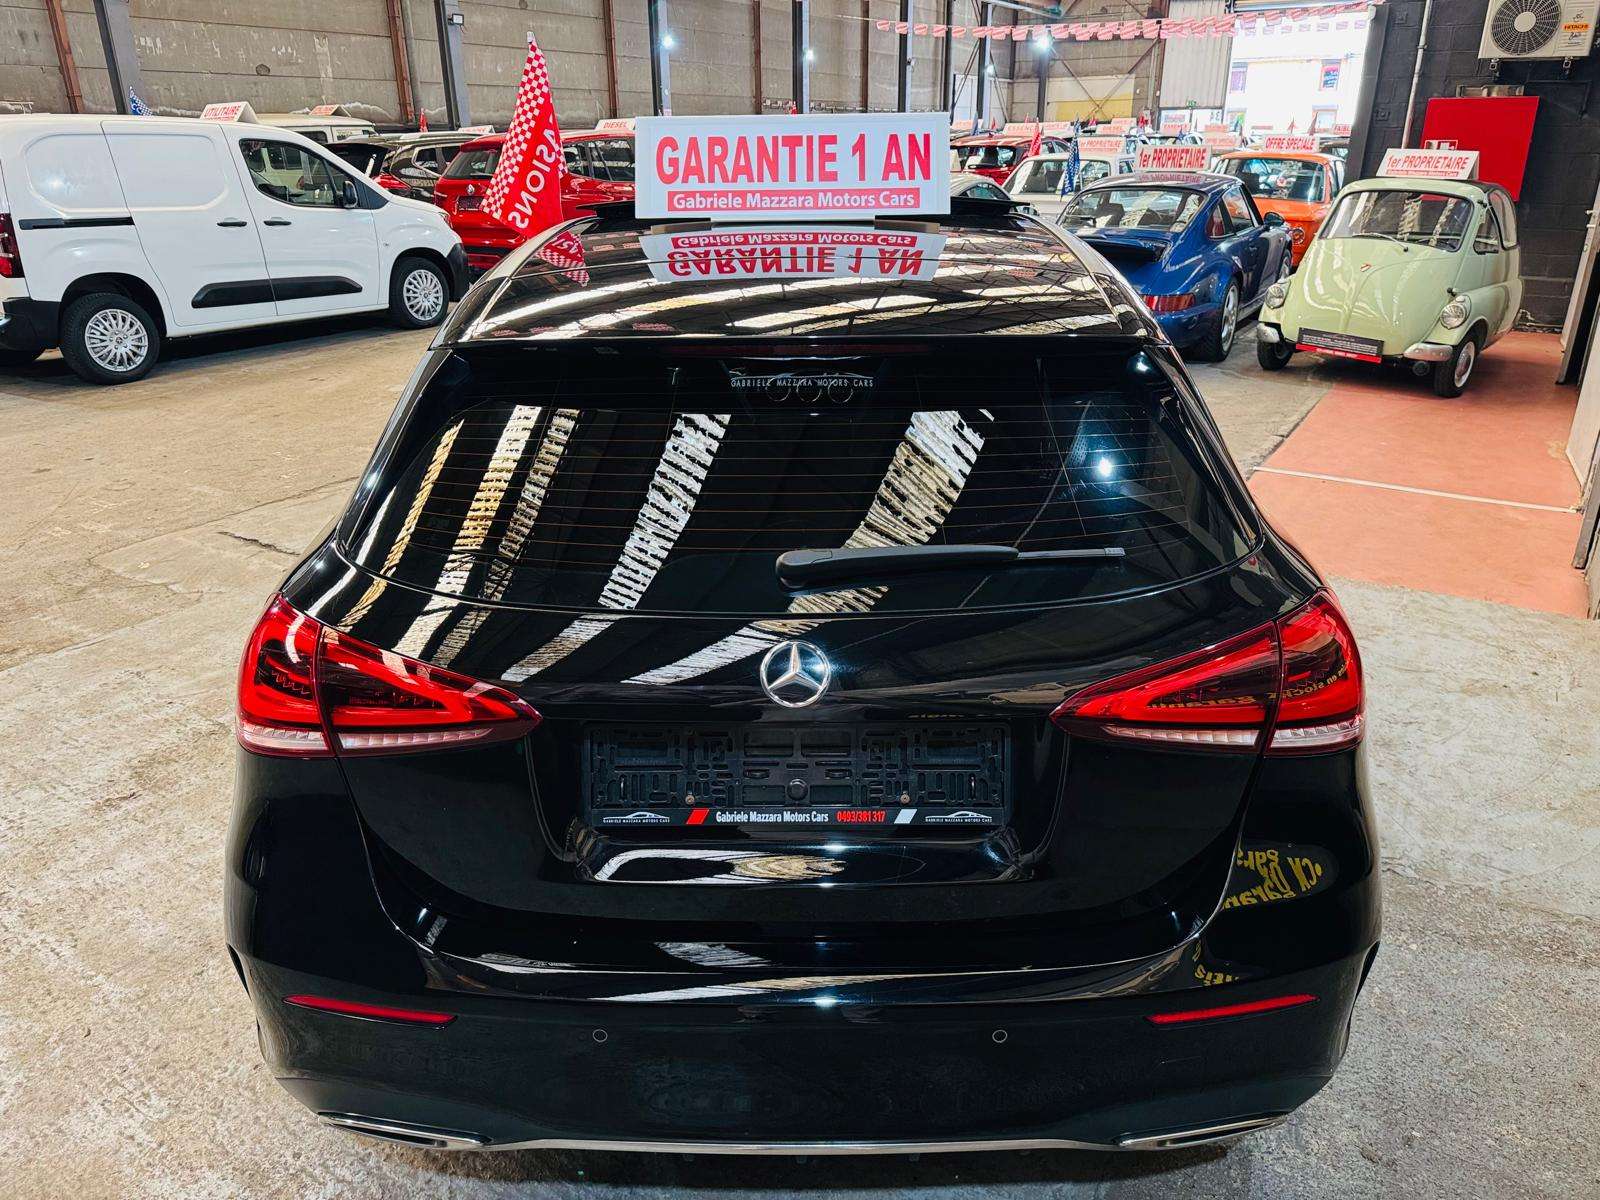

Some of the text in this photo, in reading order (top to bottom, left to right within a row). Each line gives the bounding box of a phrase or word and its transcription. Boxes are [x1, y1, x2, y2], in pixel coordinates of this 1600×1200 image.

[203, 105, 241, 118] UTILITAIRE
[603, 121, 628, 129] DIESEL
[1265, 137, 1315, 151] OFFRE SPECIALE
[656, 133, 931, 184] GARANTIE 1 AN
[1139, 148, 1207, 169] 1er PROPRIETAIRE
[1387, 155, 1470, 170] 1er PROPRIETAIRE
[673, 190, 915, 209] Gabriele Mazzara Motors Cars
[731, 379, 874, 388] GABRIELE MAZZARA MOTORS CARS
[716, 811, 749, 822] Gabriele
[750, 811, 782, 822] Mazzara
[783, 811, 810, 822] Motors
[811, 811, 829, 822] Cars
